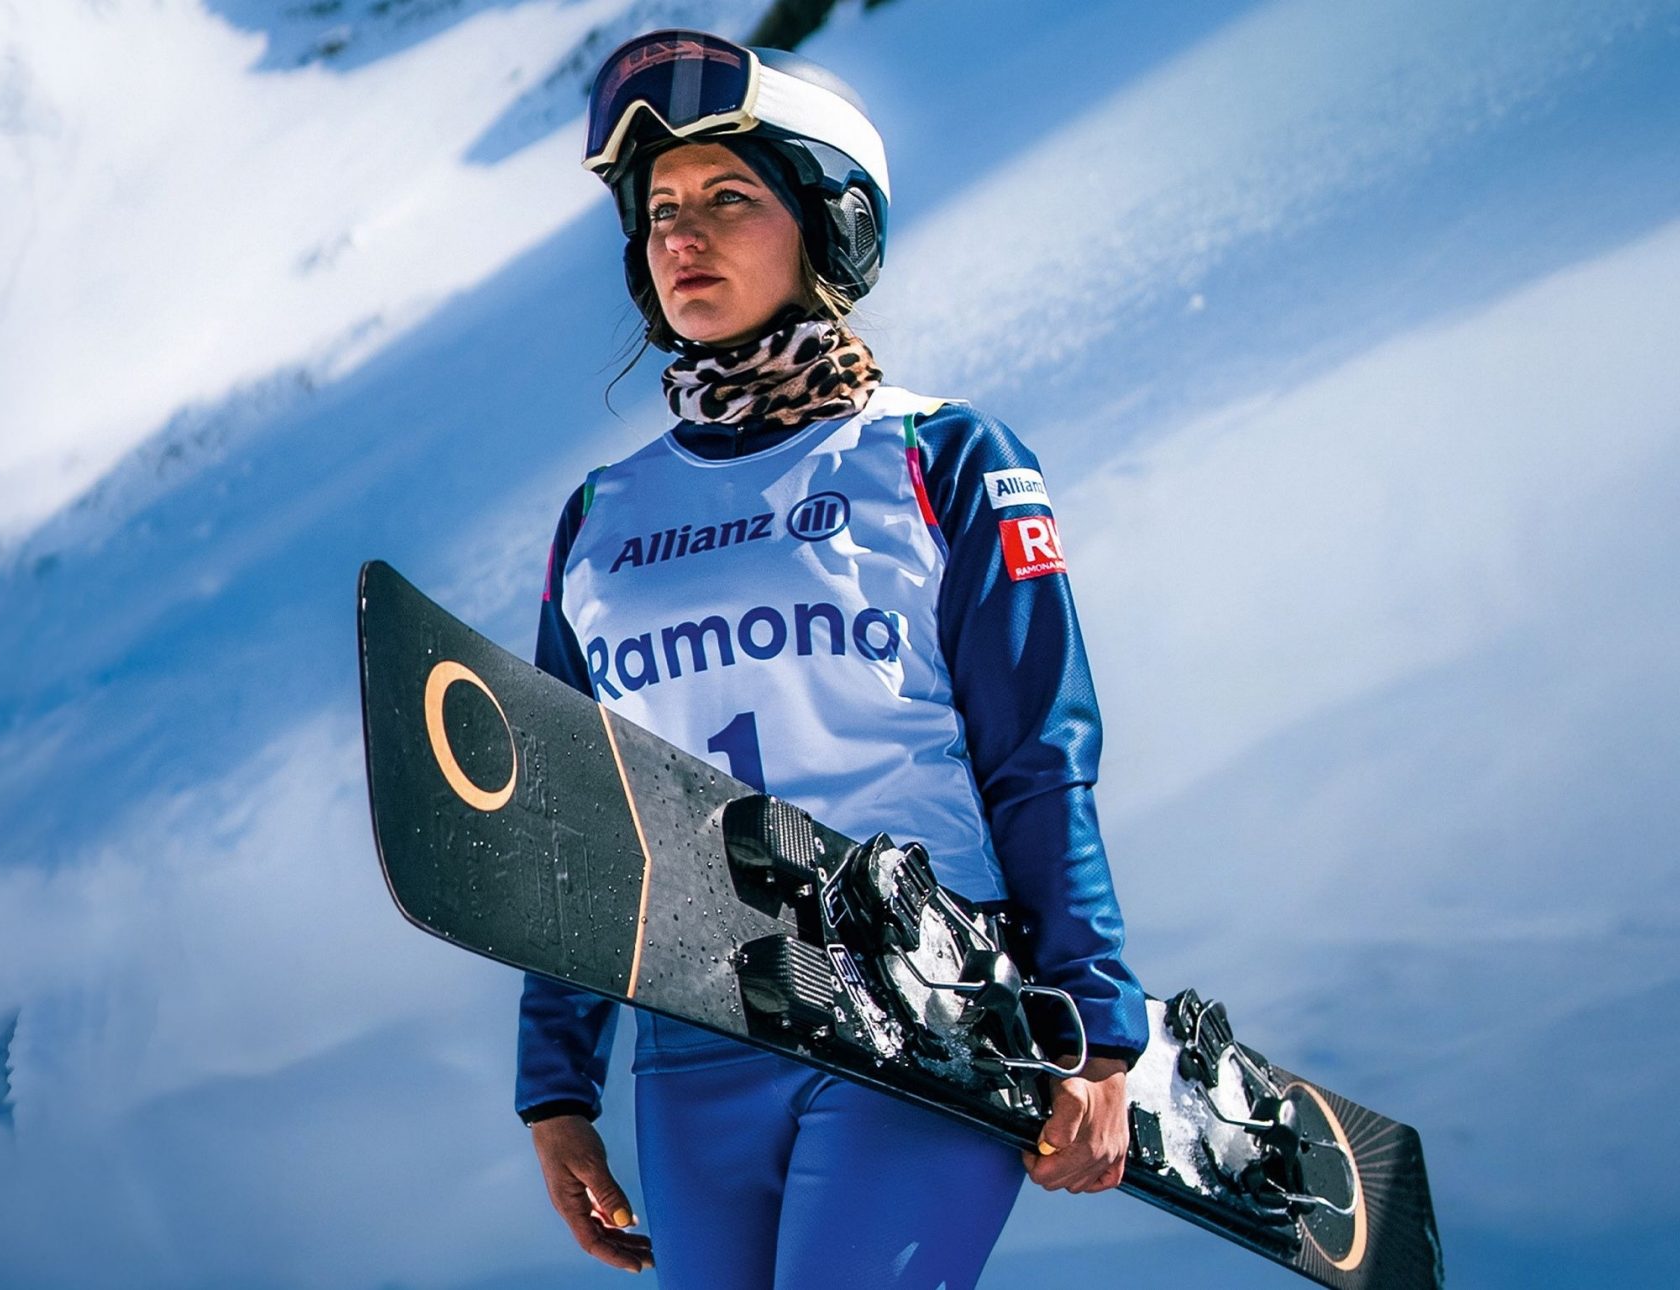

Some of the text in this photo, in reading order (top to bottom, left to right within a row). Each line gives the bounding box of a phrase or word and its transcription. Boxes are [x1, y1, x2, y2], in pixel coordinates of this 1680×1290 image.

[996, 477, 1044, 496] Allianz
[609, 512, 775, 574] Allianz
[1016, 562, 1055, 576] RAMONA
[587, 602, 901, 700] Ramona
[707, 711, 766, 793] 1
